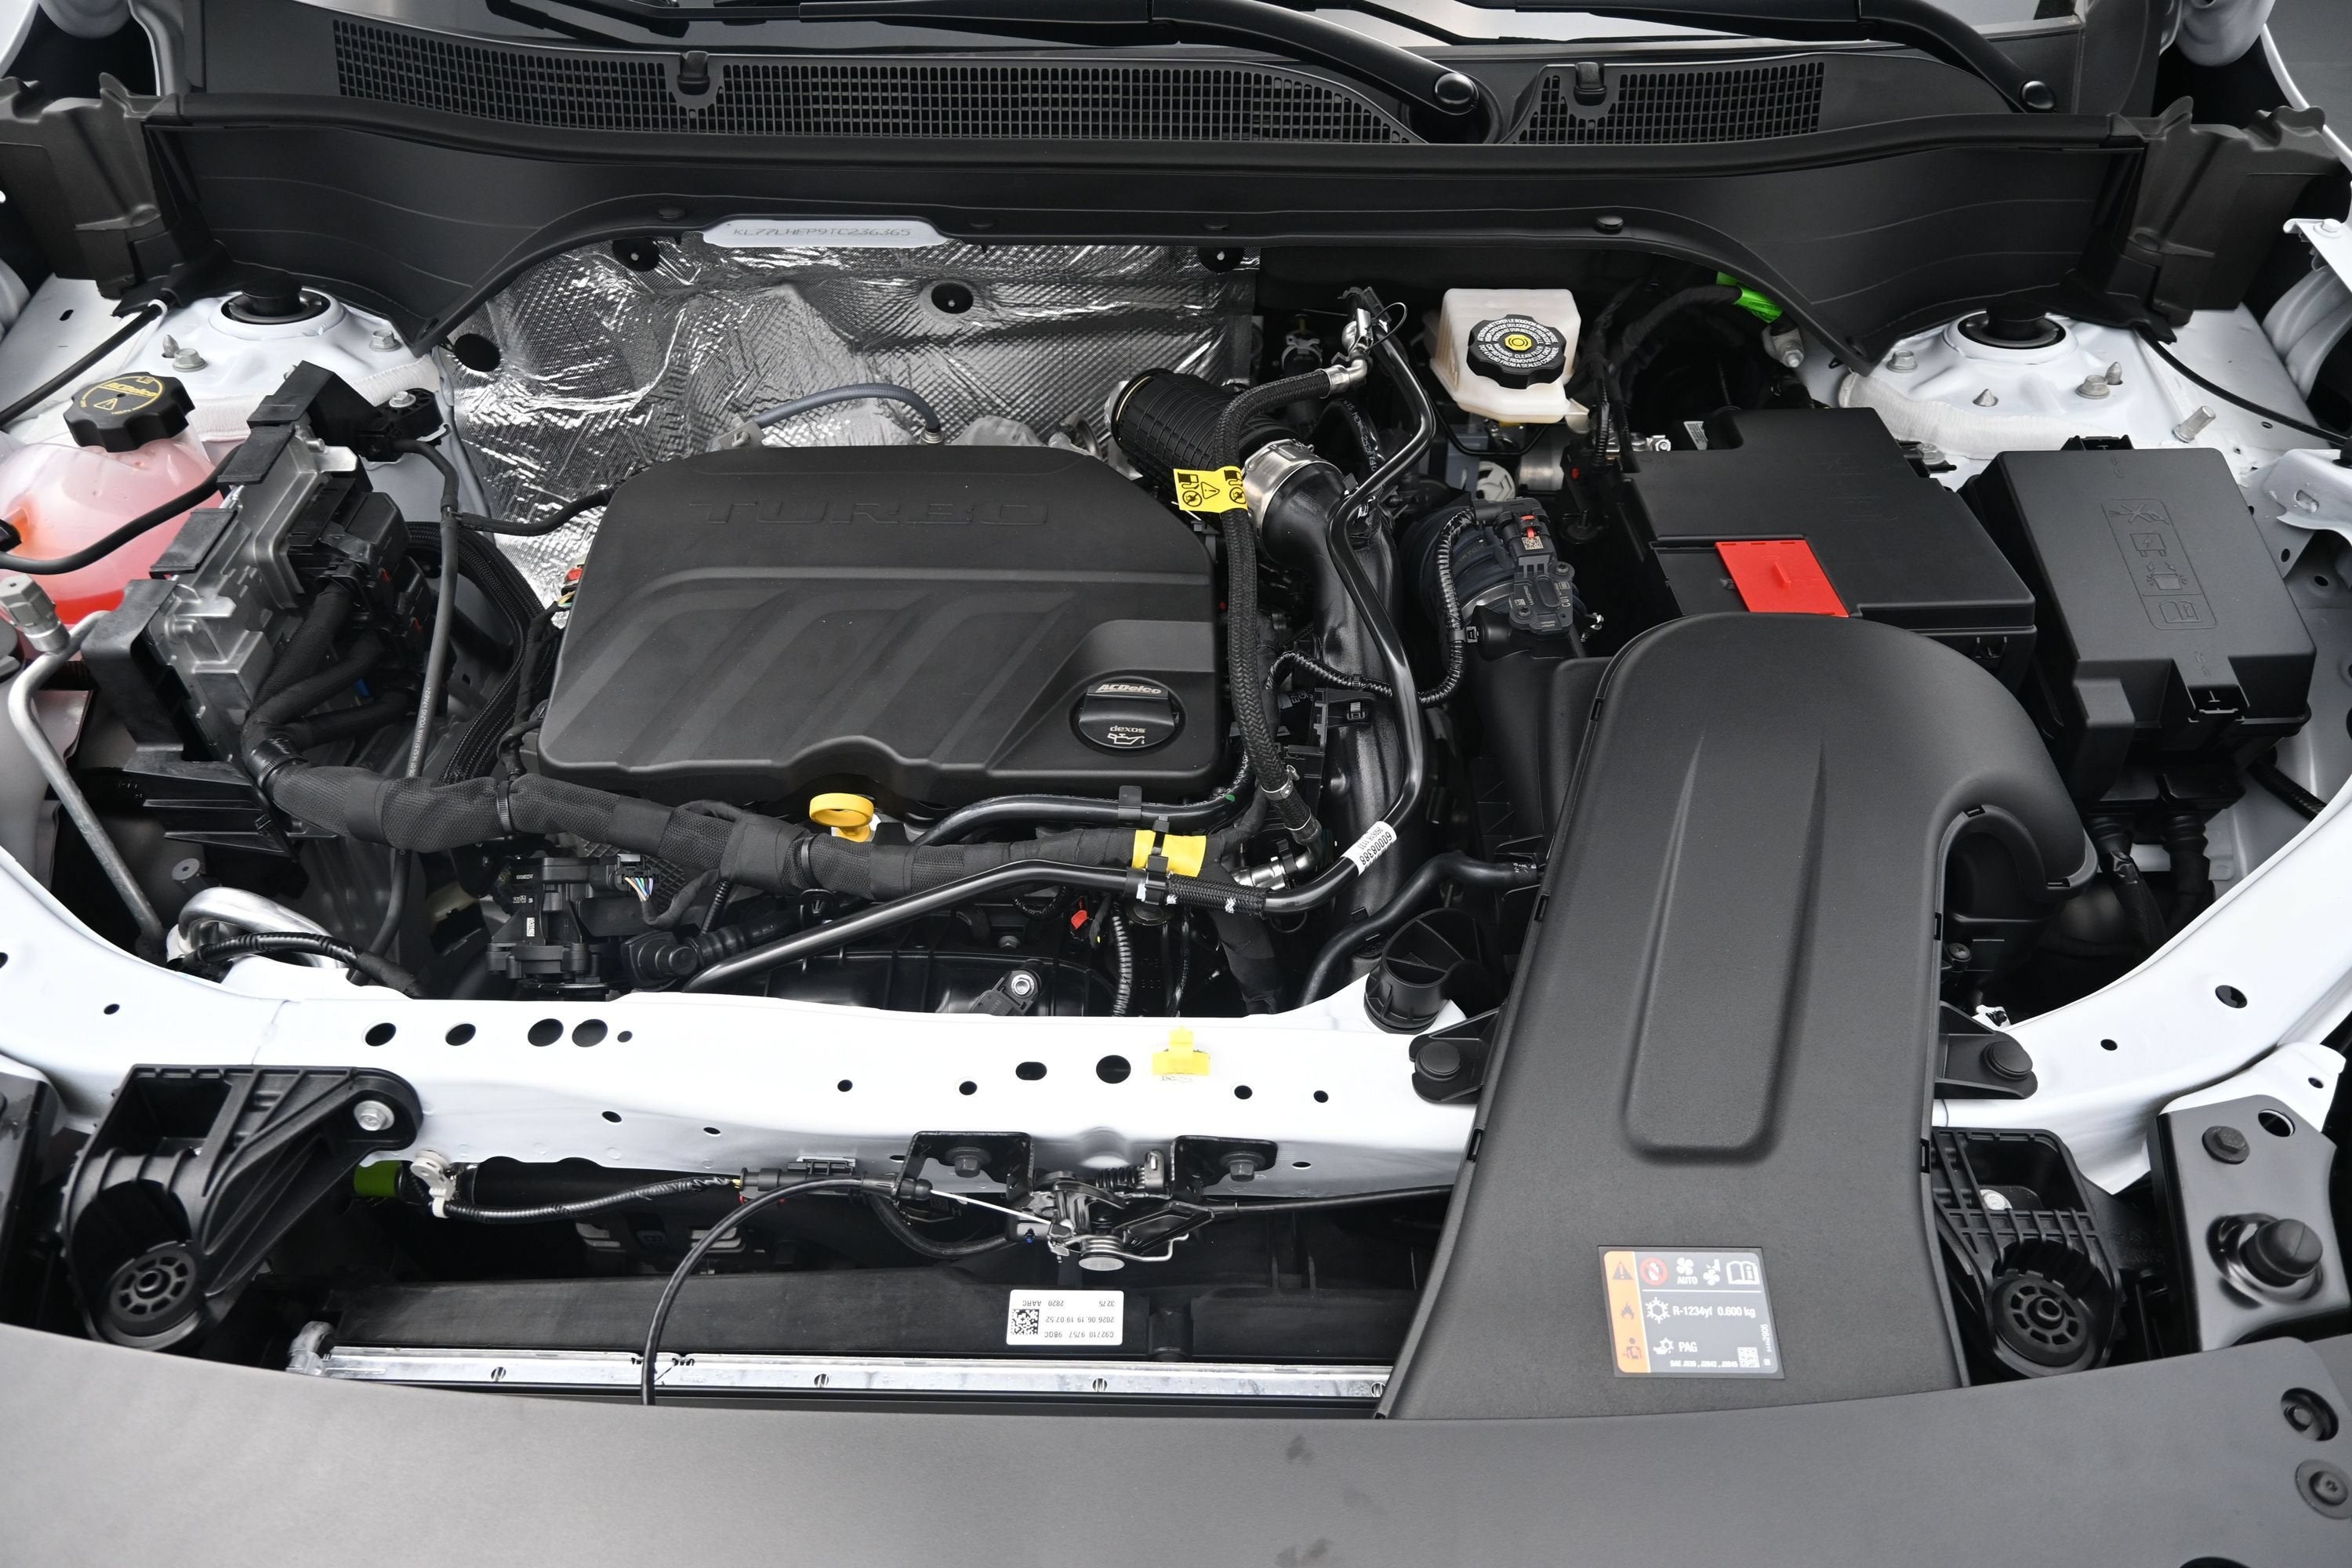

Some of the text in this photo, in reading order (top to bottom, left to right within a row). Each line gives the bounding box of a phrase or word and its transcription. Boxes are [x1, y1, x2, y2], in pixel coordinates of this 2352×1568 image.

[105, 382, 158, 397] ACDelco
[689, 502, 1049, 526] TURBO
[1095, 684, 1162, 694] ACDelco
[1359, 831, 1392, 866] 60008388
[1677, 1276, 1698, 1285] AUTO
[1672, 1306, 1756, 1318] R-1234yf 0.600 kg
[1678, 1341, 1698, 1353] PAG
